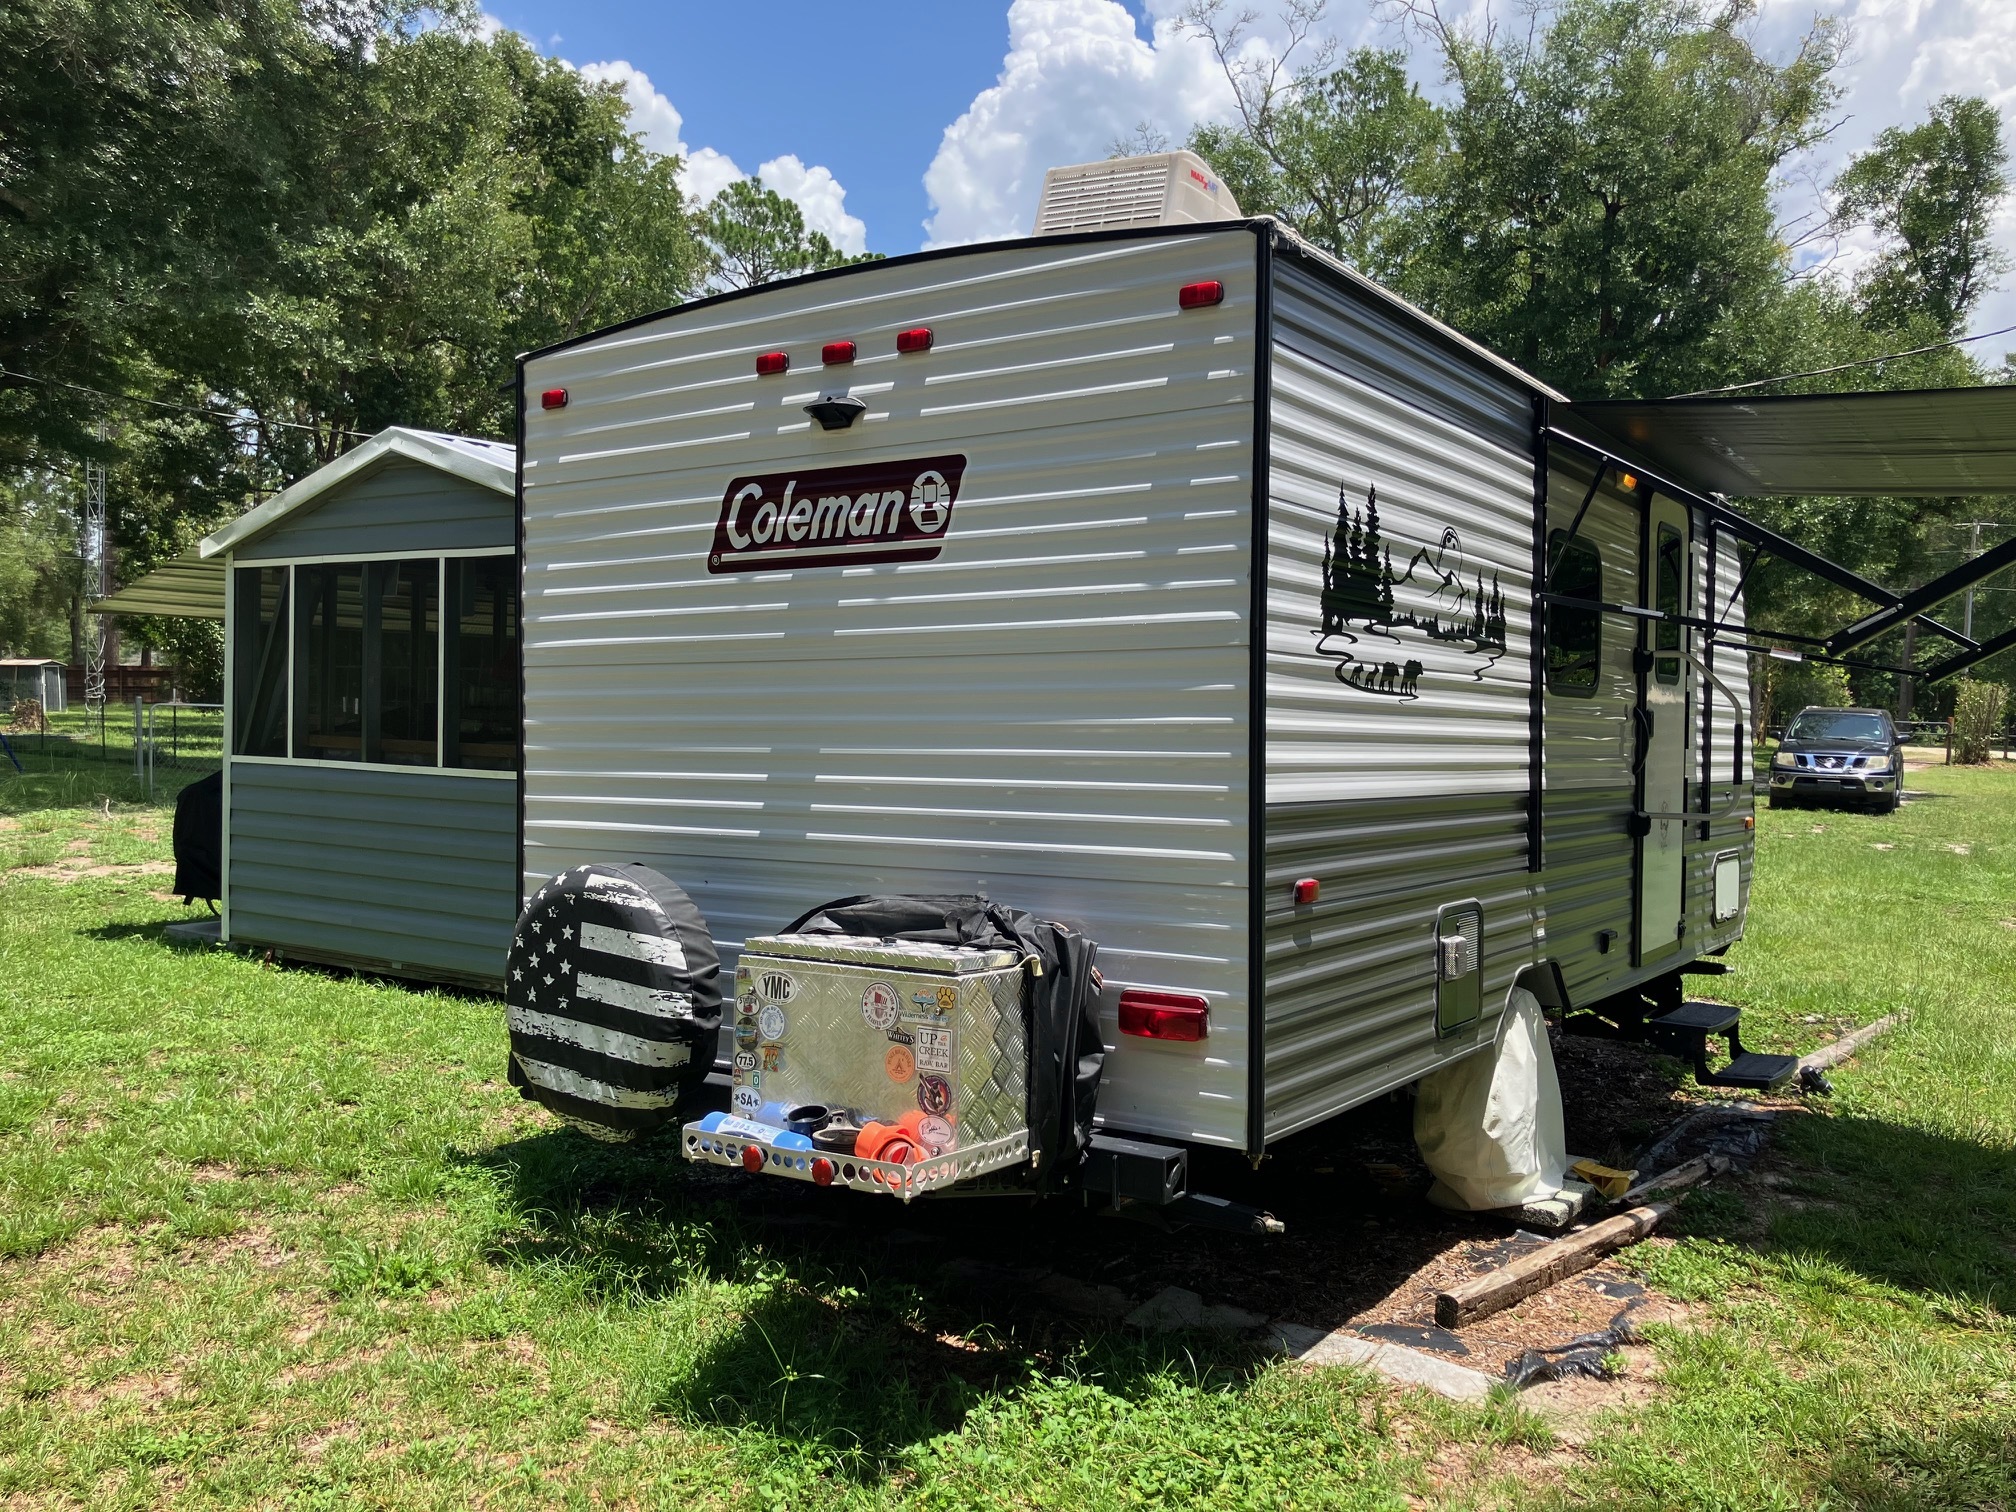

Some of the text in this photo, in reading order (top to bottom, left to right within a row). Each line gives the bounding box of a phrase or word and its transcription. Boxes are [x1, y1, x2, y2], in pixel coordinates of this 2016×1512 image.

[726, 481, 905, 549] Coleman
[763, 975, 790, 1000] YMC
[920, 1032, 938, 1045] UP
[919, 1046, 948, 1058] CREEK
[738, 1056, 754, 1067] 77.5
[919, 1059, 948, 1069] RAW BAR
[740, 1093, 753, 1107] SA
